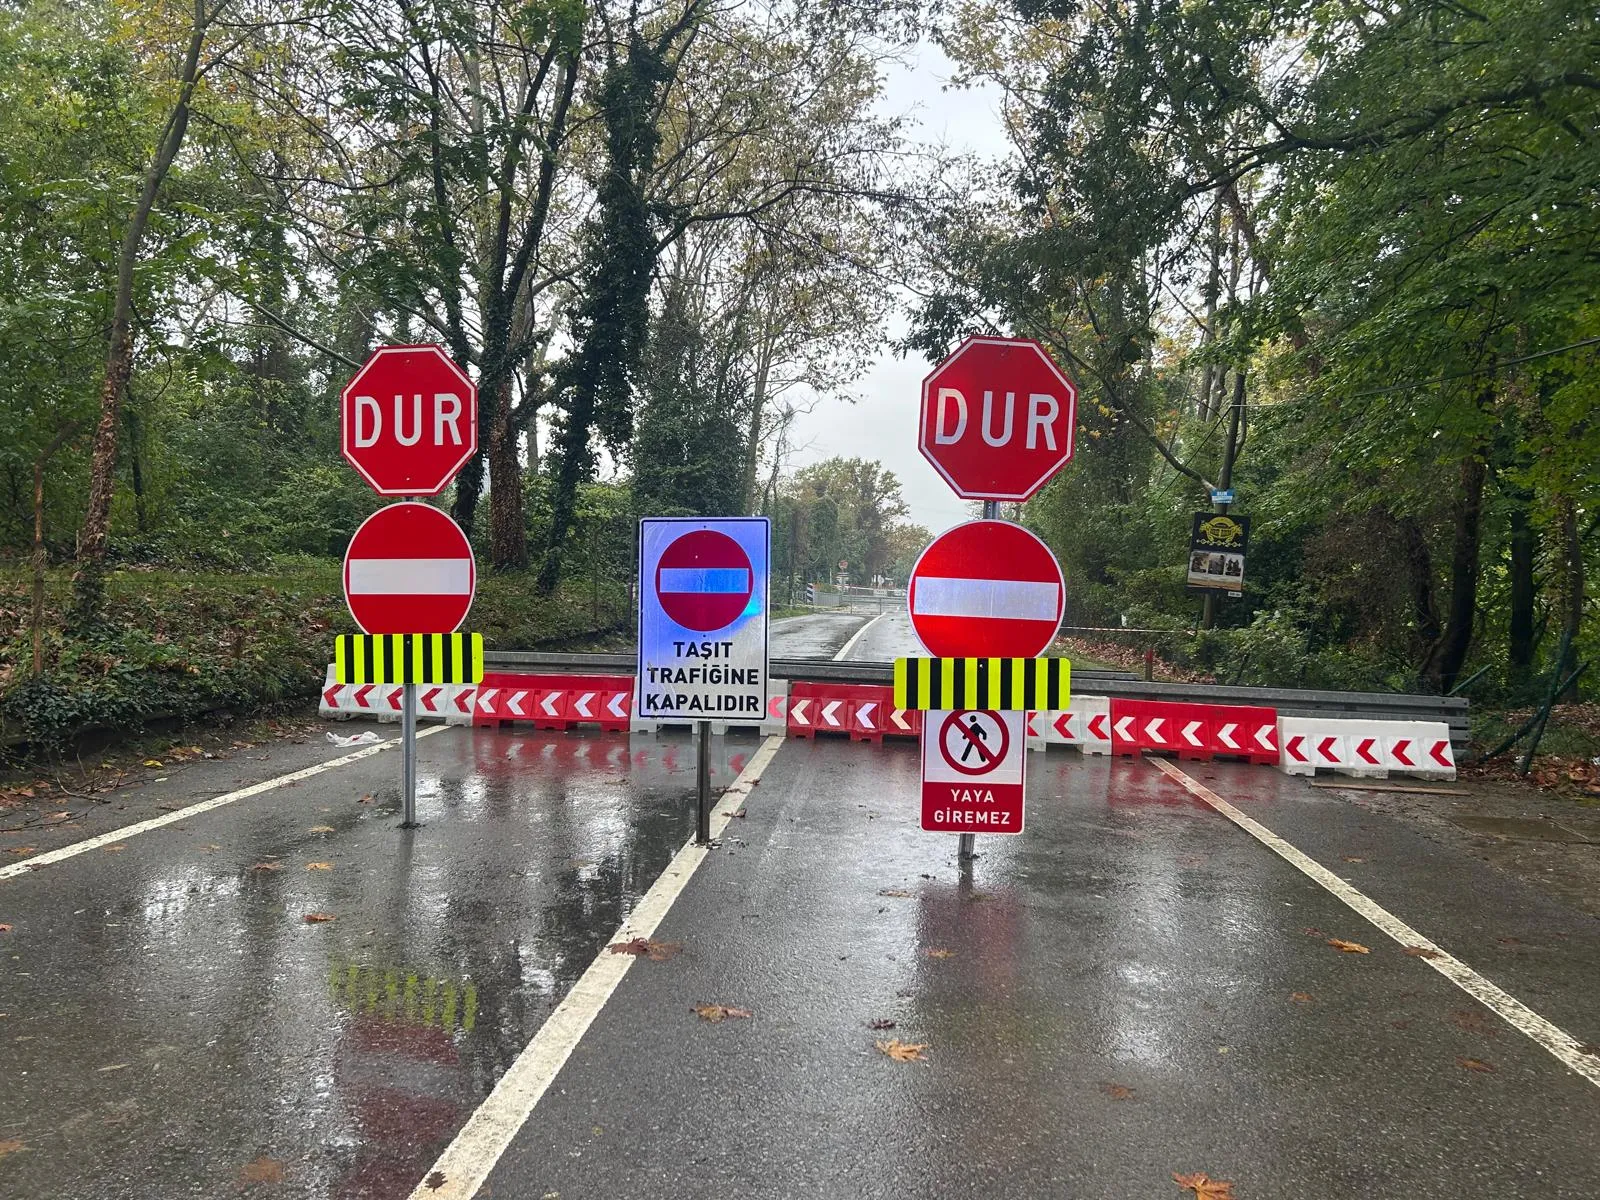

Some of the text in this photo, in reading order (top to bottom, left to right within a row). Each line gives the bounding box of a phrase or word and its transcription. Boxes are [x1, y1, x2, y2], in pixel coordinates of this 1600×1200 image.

[354, 393, 462, 448] DUR
[935, 388, 1059, 451] DUR
[673, 641, 733, 660] TAŞIT
[647, 664, 759, 685] TRAFİĞİNE
[646, 693, 759, 712] KAPALIDIR
[950, 788, 995, 804] YAYA
[934, 807, 1010, 825] GİREMEZ
